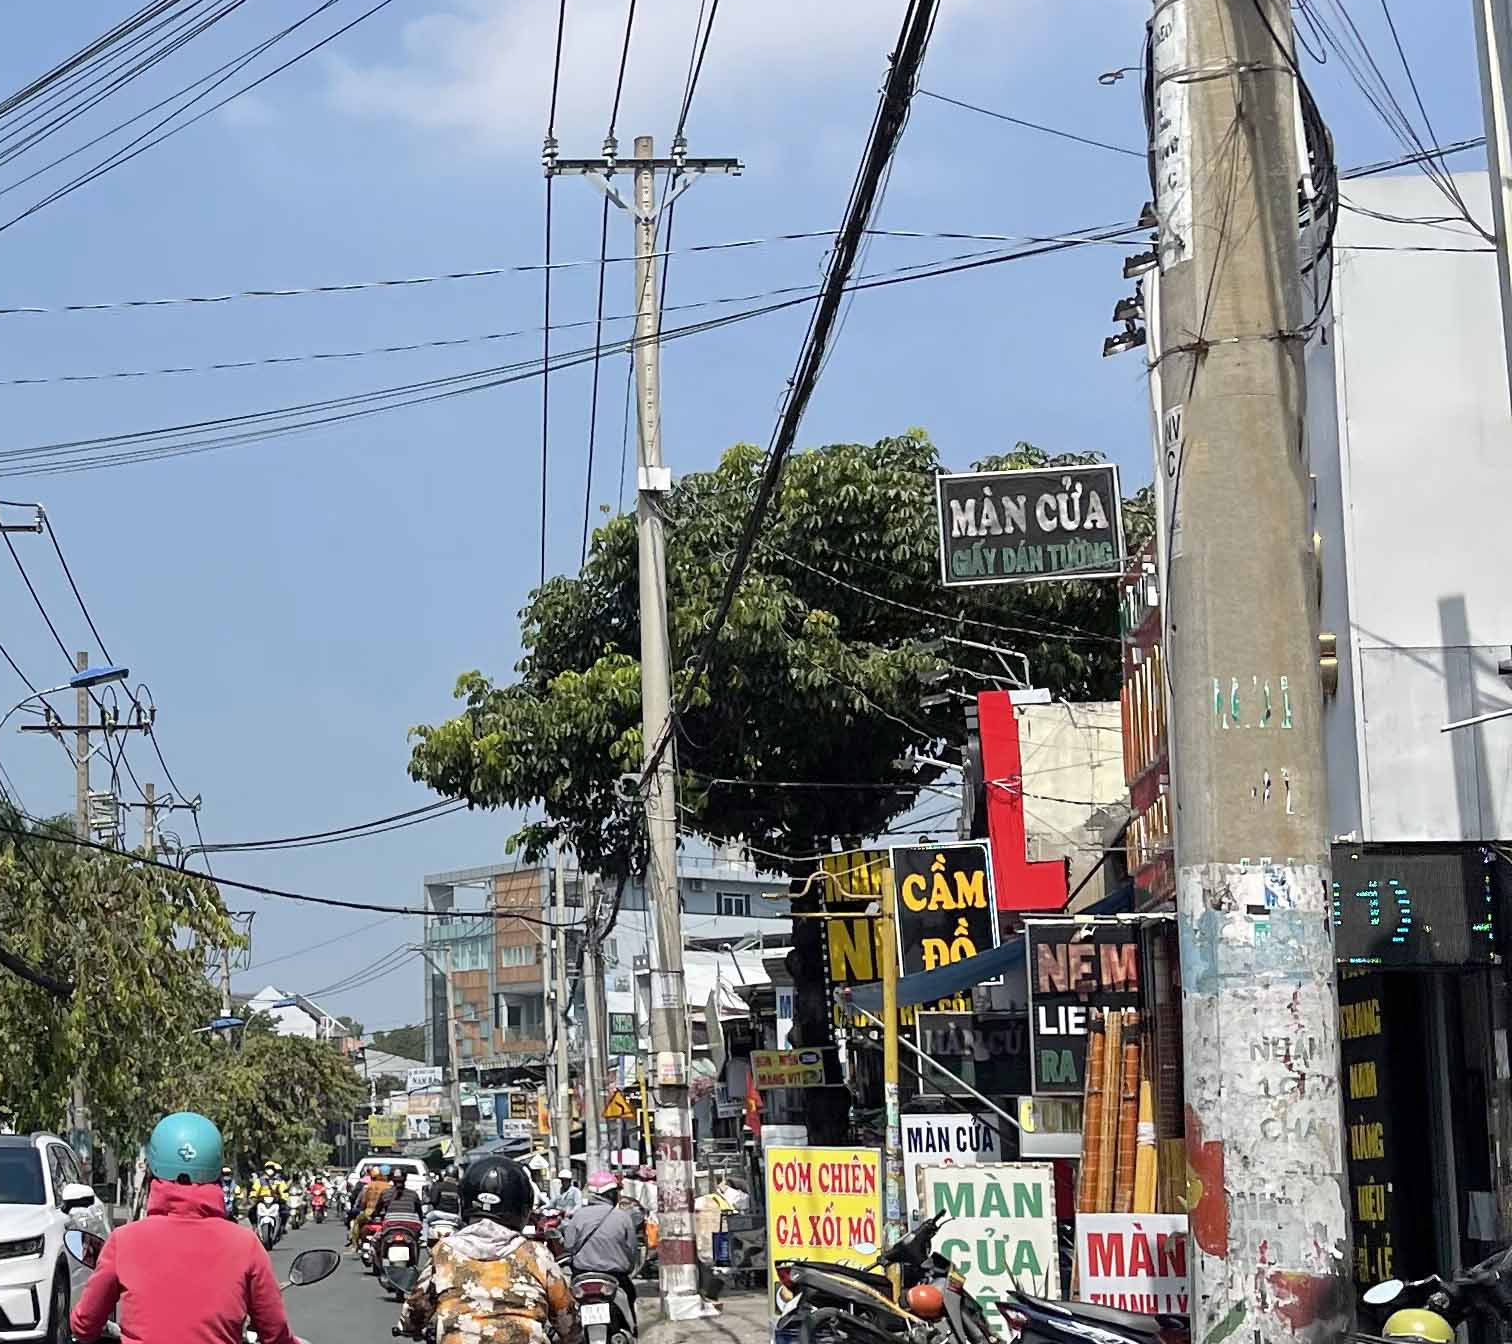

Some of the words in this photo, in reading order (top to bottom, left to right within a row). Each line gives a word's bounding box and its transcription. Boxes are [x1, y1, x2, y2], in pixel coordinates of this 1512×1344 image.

[950, 486, 1027, 539] MÀN
[1035, 476, 1110, 532] CỬA
[952, 539, 997, 577] GIẤY
[1003, 539, 1044, 573] DÁN
[1047, 536, 1114, 570] TƯỜNG
[901, 853, 988, 912] CẦM
[921, 916, 978, 971] ĐỒ
[1041, 1049, 1078, 1084] RA
[907, 1120, 950, 1153] MÀN
[956, 1112, 994, 1153] CỬA
[772, 1157, 812, 1193] CƠM
[818, 1154, 877, 1194] CHIÊN
[933, 1173, 1044, 1219] MÀN
[776, 1206, 804, 1246] GÀ
[809, 1201, 843, 1247] XỐI
[848, 1207, 877, 1246] MỠ
[940, 1227, 1043, 1277] CỬA
[1087, 1223, 1187, 1278] MÀN
